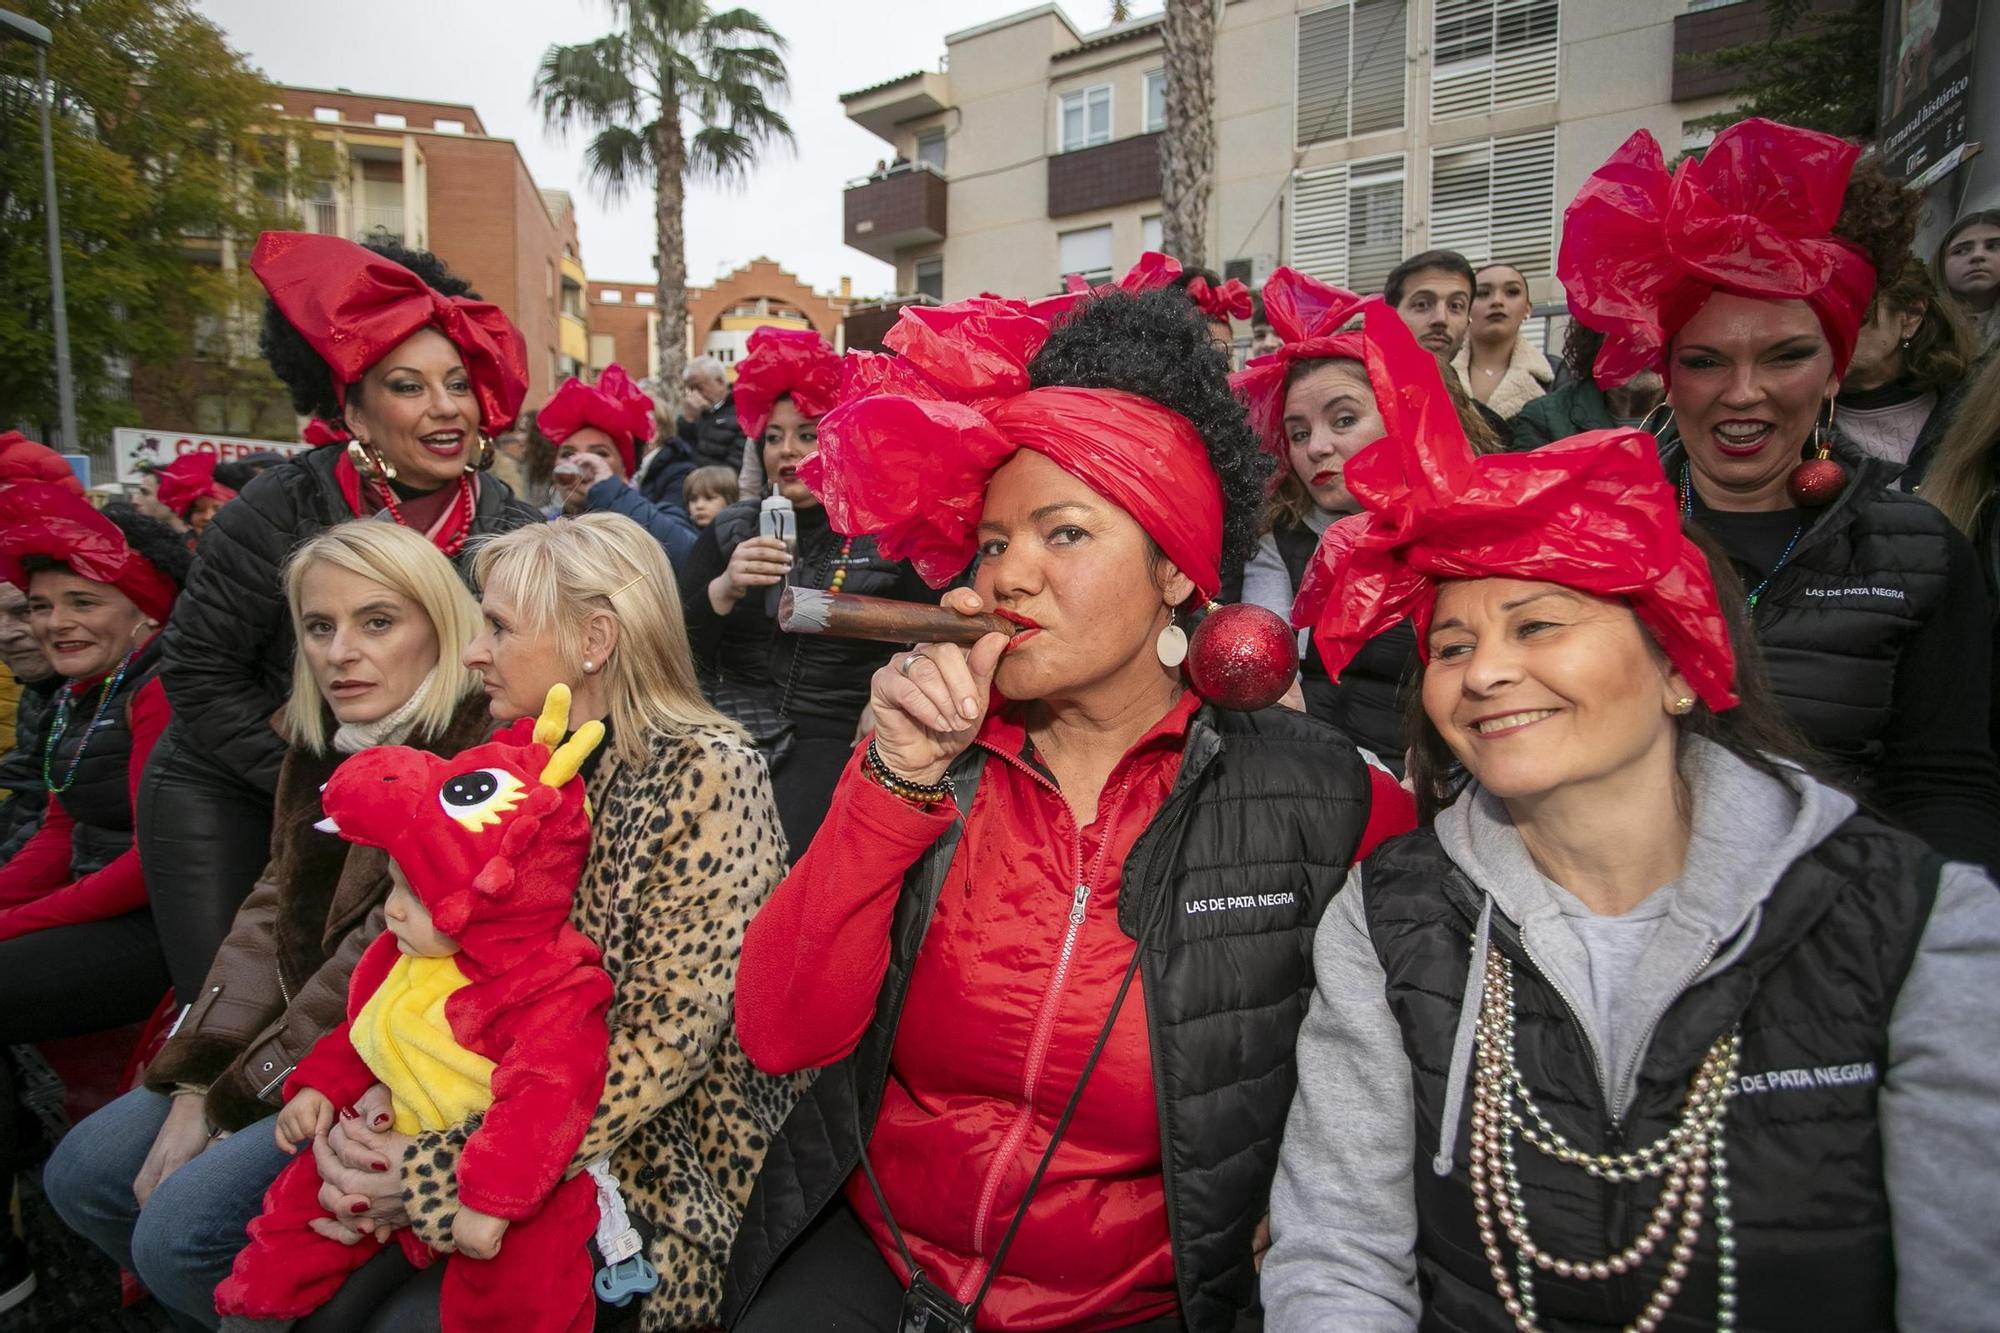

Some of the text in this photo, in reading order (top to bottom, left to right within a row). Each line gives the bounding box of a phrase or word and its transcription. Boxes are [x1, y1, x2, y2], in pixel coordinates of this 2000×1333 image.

[1883, 109, 1921, 154] Carnaval
[1922, 75, 1969, 122] histórico
[1805, 586, 1905, 600] LAS DE PATA NEGRA
[1185, 892, 1295, 914] LAS DE PATA NEGRA
[1740, 1074, 1769, 1093] DE
[1766, 1069, 1814, 1089] PATA
[1813, 1062, 1875, 1085] NEGRA
